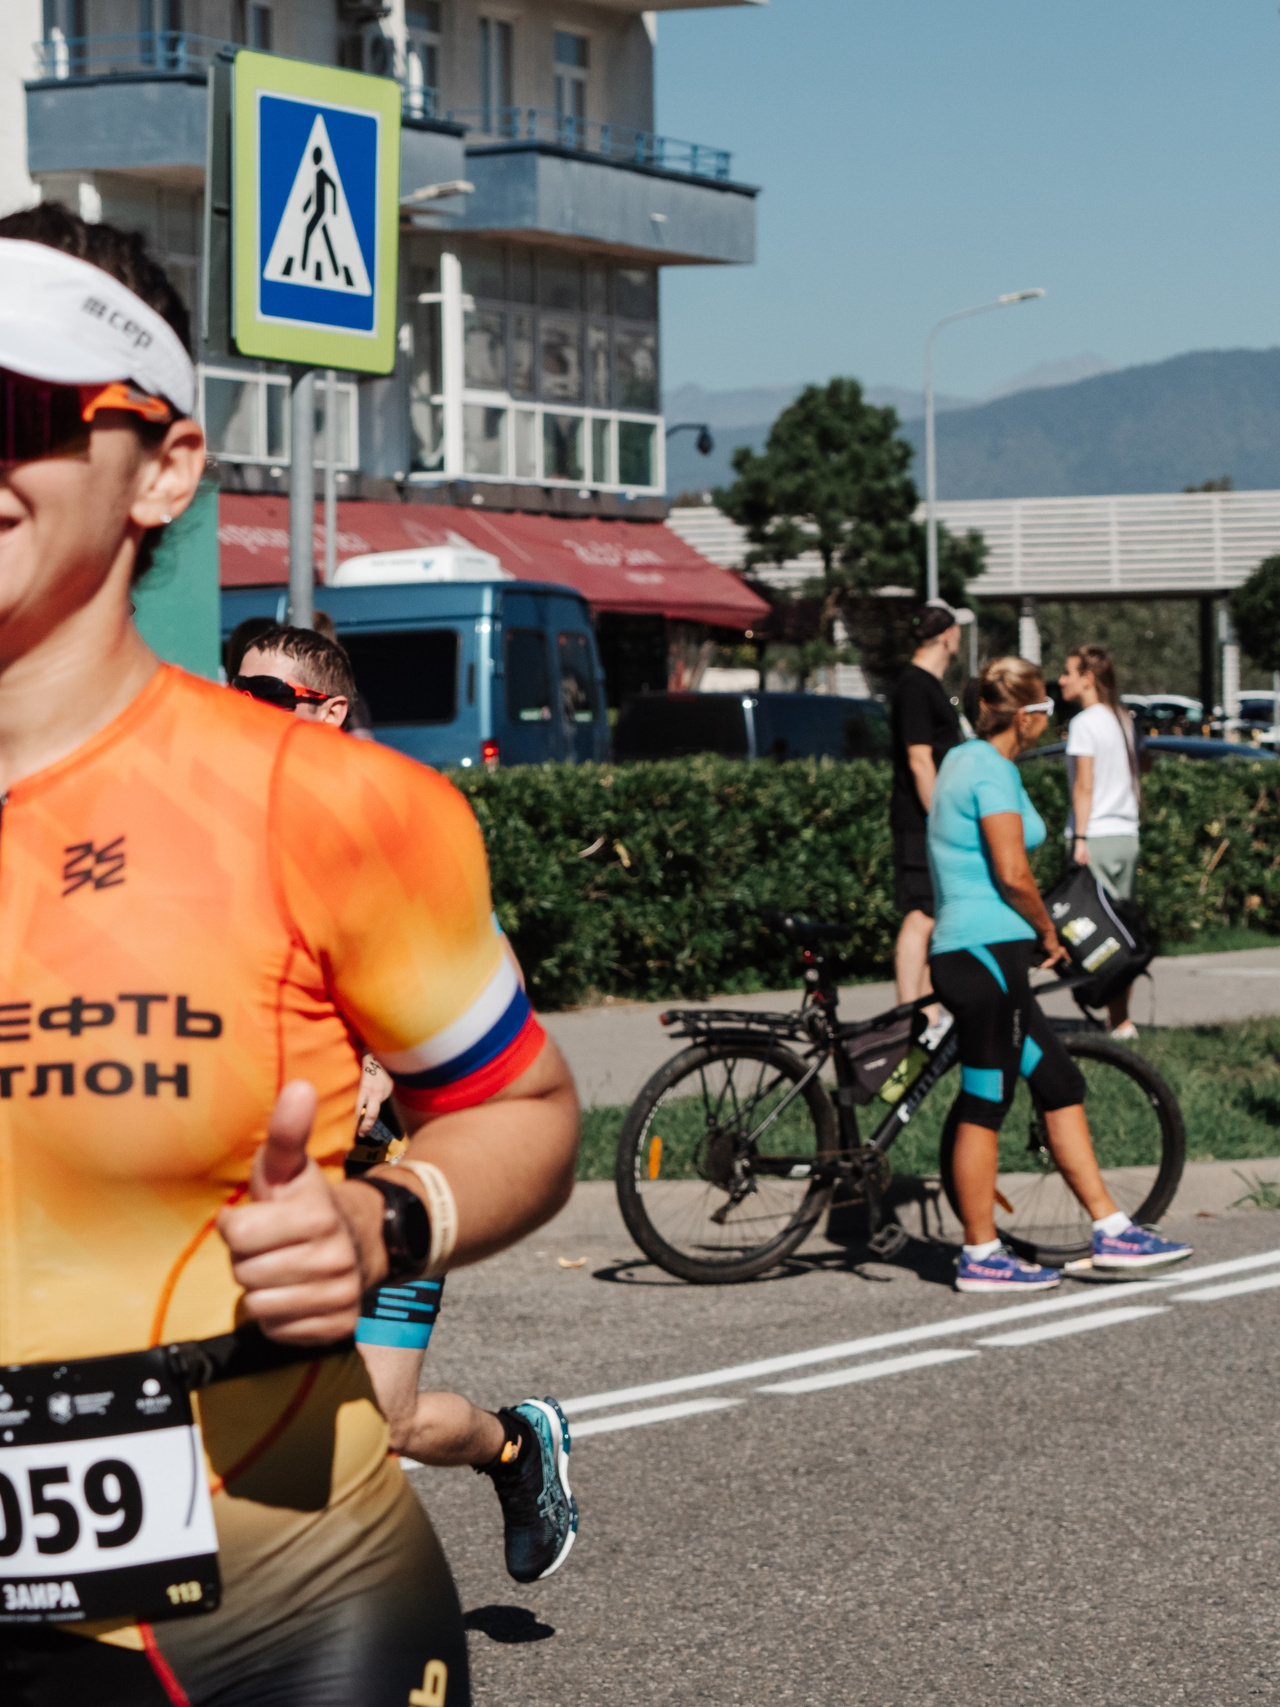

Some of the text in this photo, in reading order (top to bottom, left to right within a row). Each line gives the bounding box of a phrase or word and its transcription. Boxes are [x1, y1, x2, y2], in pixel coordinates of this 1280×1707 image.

[108, 311, 153, 349] cep
[2, 1580, 81, 1611] ЗАИРА
[166, 1581, 204, 1606] 113
